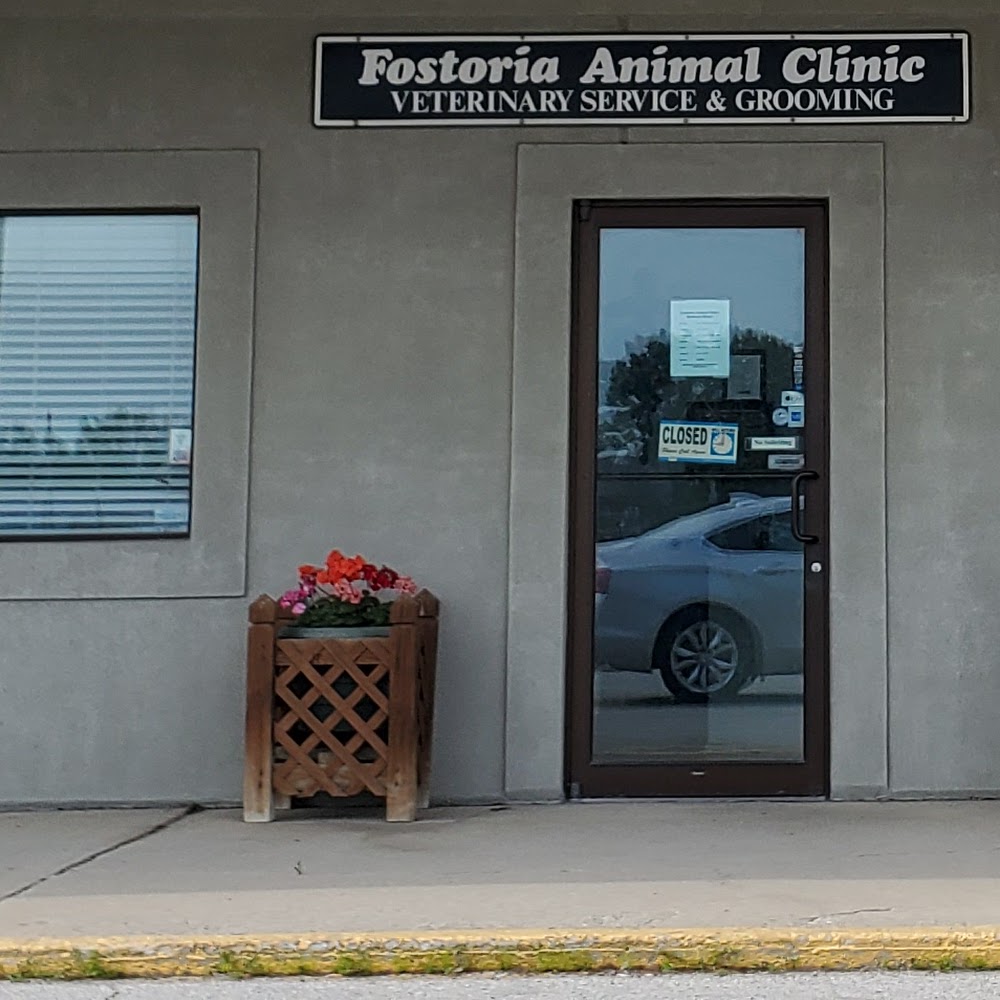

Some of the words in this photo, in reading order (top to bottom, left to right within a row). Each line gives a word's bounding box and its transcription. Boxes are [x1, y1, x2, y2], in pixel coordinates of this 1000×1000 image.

[358, 46, 559, 85] Fostoria
[580, 46, 761, 83] Animal
[782, 45, 925, 83] Clinic
[390, 89, 573, 112] VETERINARY
[580, 90, 697, 112] SERVICE
[706, 89, 727, 112] &
[735, 88, 895, 112] GROOMING
[662, 426, 708, 446] CLOSED
